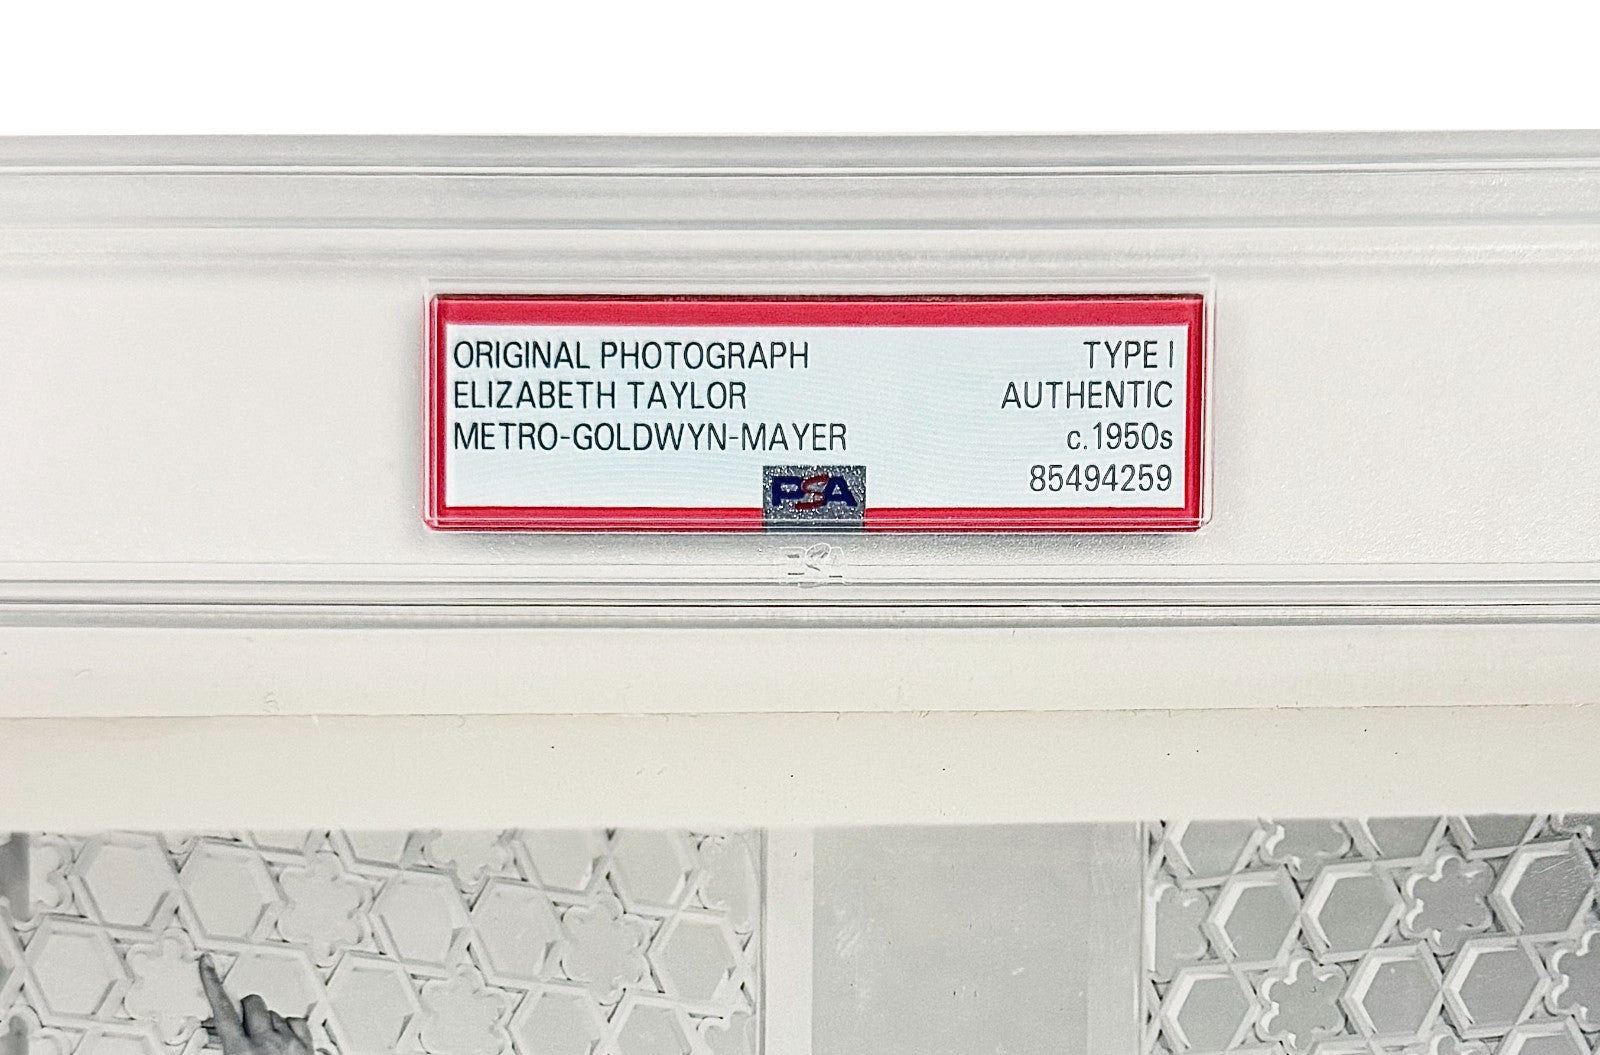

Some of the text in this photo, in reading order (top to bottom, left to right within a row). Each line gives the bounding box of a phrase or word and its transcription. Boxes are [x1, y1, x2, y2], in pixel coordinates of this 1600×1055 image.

[453, 340, 809, 370] ORIGINAL PHOTOGRAPH
[1083, 340, 1174, 369] TYPE I
[454, 380, 747, 410] ELIZABETH TAYLOR
[1000, 379, 1173, 409] AUTHENTIC
[454, 421, 847, 451] METRO-GOLDWYN-MAYER
[1066, 421, 1173, 451] c.1950s
[771, 474, 858, 510] PSA
[1029, 463, 1172, 492] 85494259
